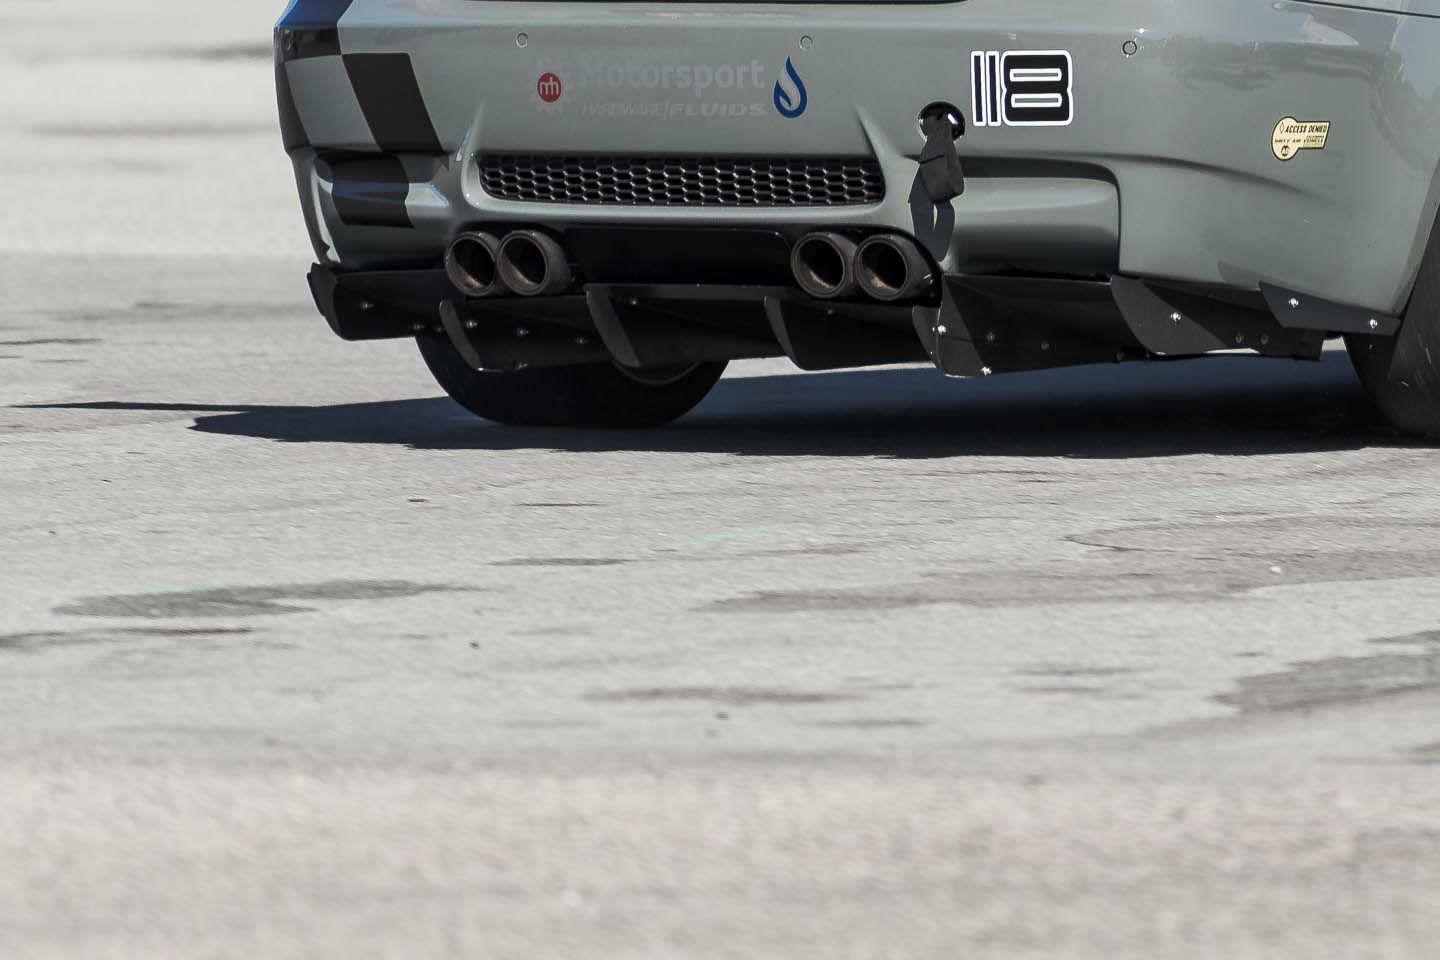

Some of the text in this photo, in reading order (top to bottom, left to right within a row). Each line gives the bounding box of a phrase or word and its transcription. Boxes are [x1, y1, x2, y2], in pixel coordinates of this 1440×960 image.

[577, 58, 766, 97] Motorsport
[970, 49, 1074, 127] 118
[1284, 124, 1328, 134] ACCESS DENIED
